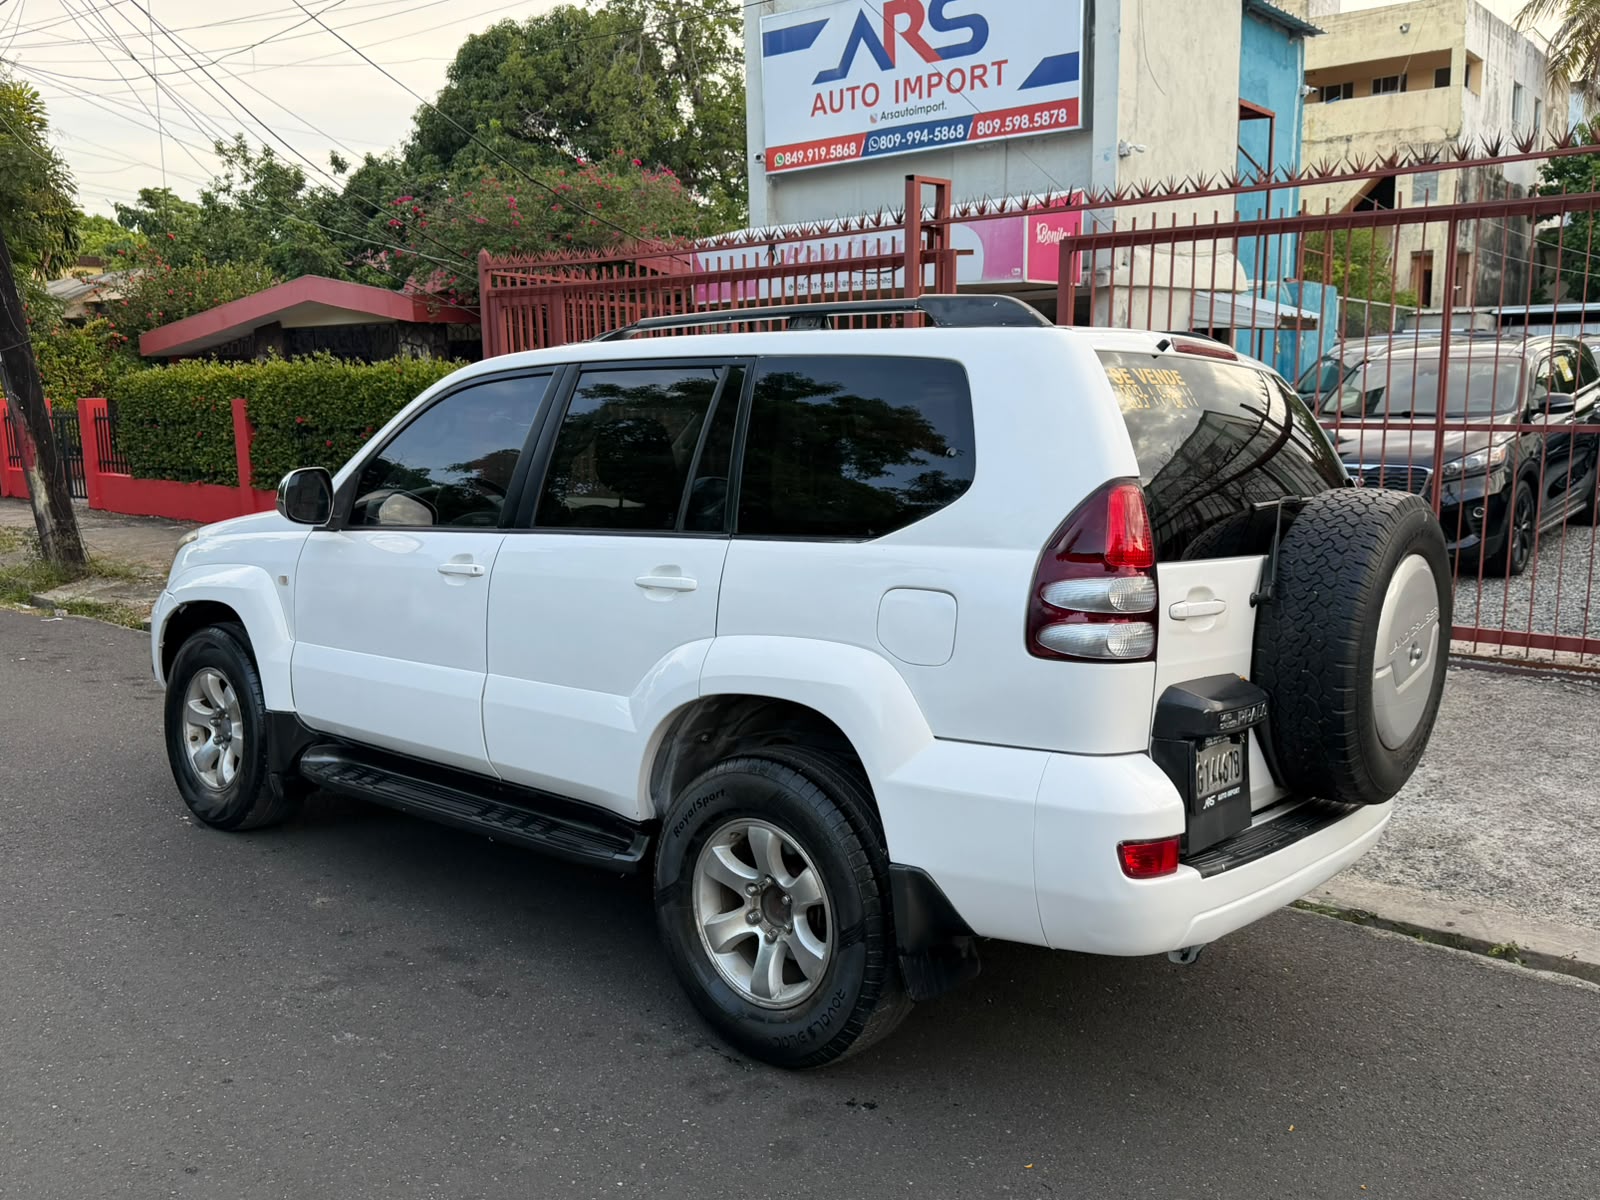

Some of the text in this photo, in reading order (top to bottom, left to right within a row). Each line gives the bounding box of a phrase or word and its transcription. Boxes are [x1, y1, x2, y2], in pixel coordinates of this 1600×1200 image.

[811, 0, 989, 85] ARS
[810, 59, 1009, 117] AUTO IMPORT
[784, 108, 1068, 166] 849.919.5868 809-994-5868 809.598.5878
[1108, 367, 1187, 386] SE VENDE
[673, 788, 725, 838] RoyalSport
